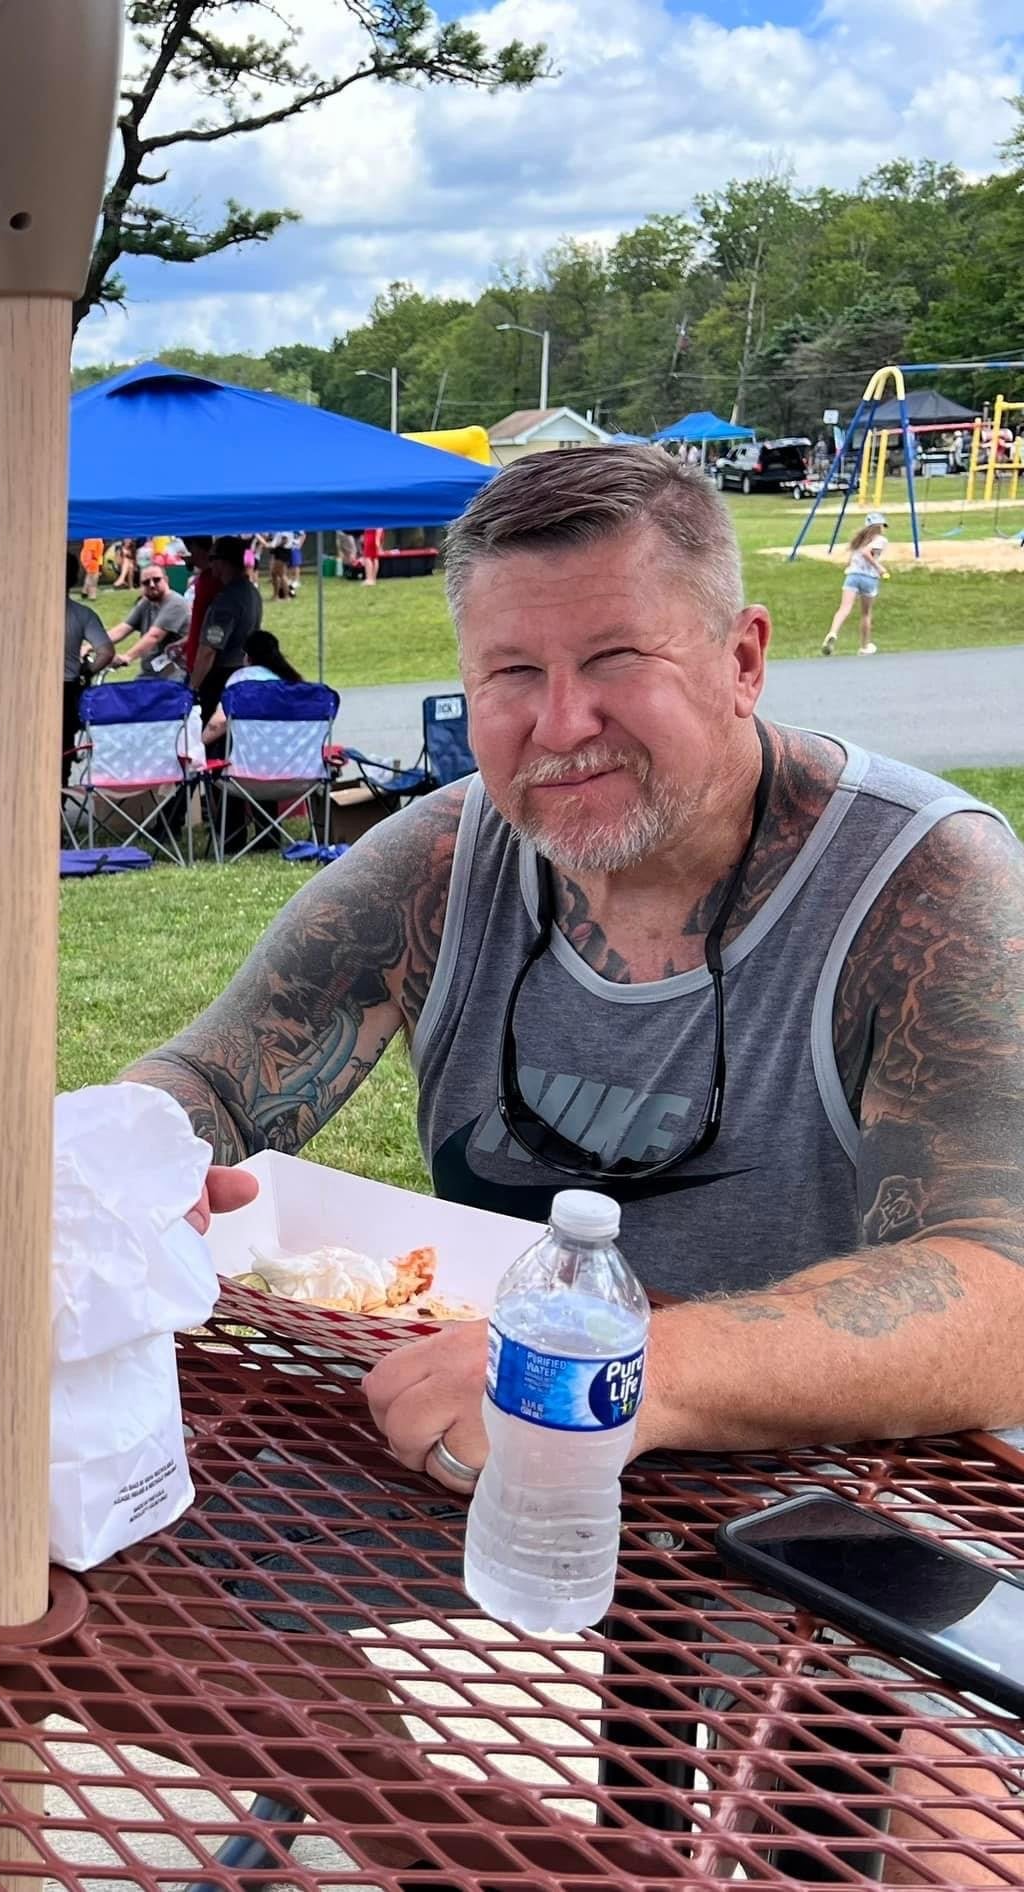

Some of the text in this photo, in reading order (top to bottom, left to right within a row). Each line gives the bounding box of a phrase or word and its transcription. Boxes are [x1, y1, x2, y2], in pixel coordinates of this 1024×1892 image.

[473, 1065, 693, 1167] NIKE
[525, 1361, 557, 1377] WATER
[526, 1351, 567, 1370] PURIFIED
[606, 1353, 643, 1382] Pure
[610, 1375, 639, 1403] Life
